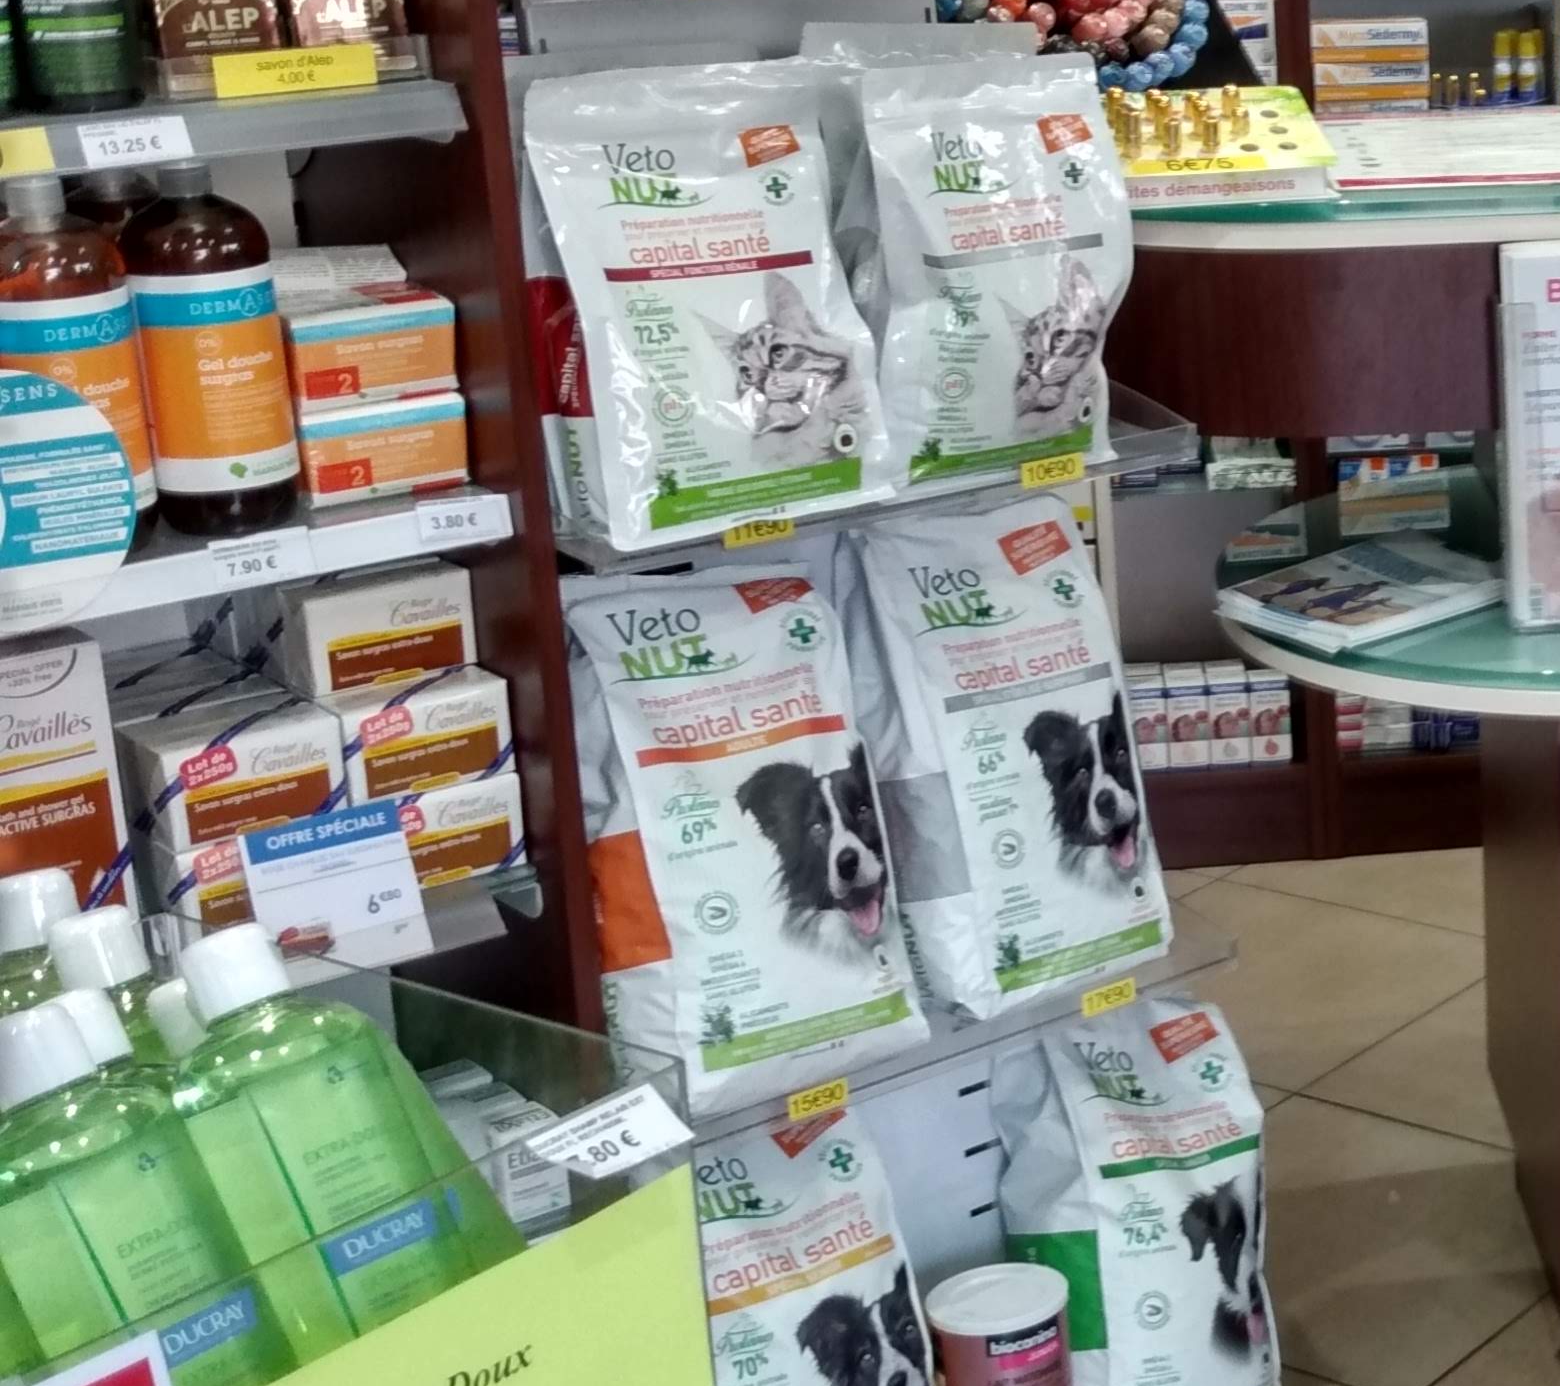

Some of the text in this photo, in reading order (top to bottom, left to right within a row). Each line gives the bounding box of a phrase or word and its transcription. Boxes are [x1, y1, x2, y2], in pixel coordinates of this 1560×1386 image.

[256, 54, 334, 72] savon d'Alep
[277, 71, 316, 83] 4.00 €
[99, 136, 162, 156] 13.25 €
[603, 143, 675, 174] Veto
[1165, 158, 1234, 171] 6€75
[1165, 178, 1295, 198] démangeaisons
[630, 231, 769, 265] capital santé
[338, 374, 352, 391] 2
[351, 467, 365, 484] 2
[1026, 461, 1074, 482] 10€90
[431, 512, 477, 530] 3.80 €
[227, 555, 278, 575] 7.90 €
[909, 566, 981, 597] Veto
[606, 607, 700, 645] Veto
[955, 645, 1090, 691] capital santé
[653, 691, 822, 747] capital santé
[42, 803, 95, 825] SURGRAS
[266, 813, 386, 851] OFFRE SPÉCIALE
[791, 1084, 845, 1113] 15€90
[621, 1130, 641, 1146] €
[342, 1210, 426, 1257] DUCRAY
[713, 1216, 874, 1294] capital santé
[164, 1301, 245, 1357] DUCRAY
